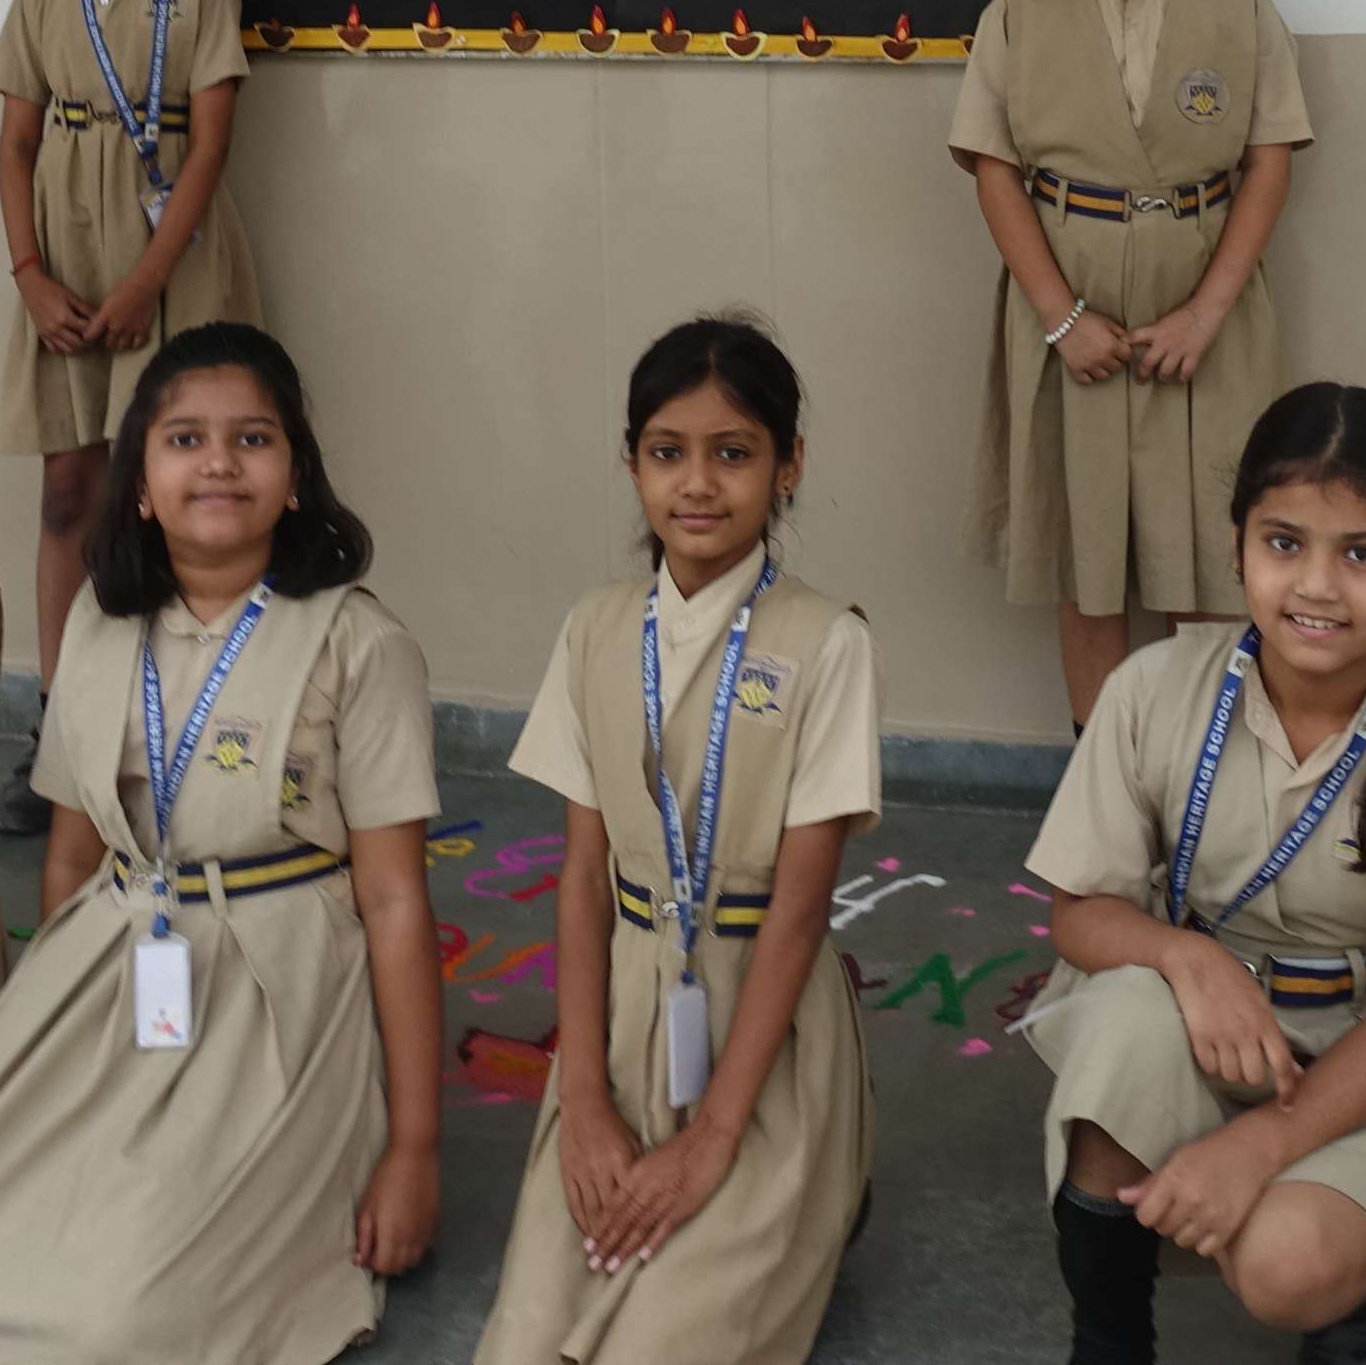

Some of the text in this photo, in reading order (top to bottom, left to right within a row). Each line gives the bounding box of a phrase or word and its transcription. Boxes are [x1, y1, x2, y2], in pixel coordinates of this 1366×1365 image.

[155, 2, 170, 57] HERITAGE
[144, 682, 165, 756] HERITAGE
[184, 671, 227, 748] HERITAGE
[217, 612, 259, 671] SCHOOL
[642, 627, 656, 691] SCHOOL
[692, 638, 740, 891] THE INDIAN HERITAGE SCHOOL
[1175, 687, 1237, 889] INDIAN HERITAGE SCHOOL
[1261, 808, 1319, 881] HERITAGE
[1311, 749, 1361, 813] SCHOOL
